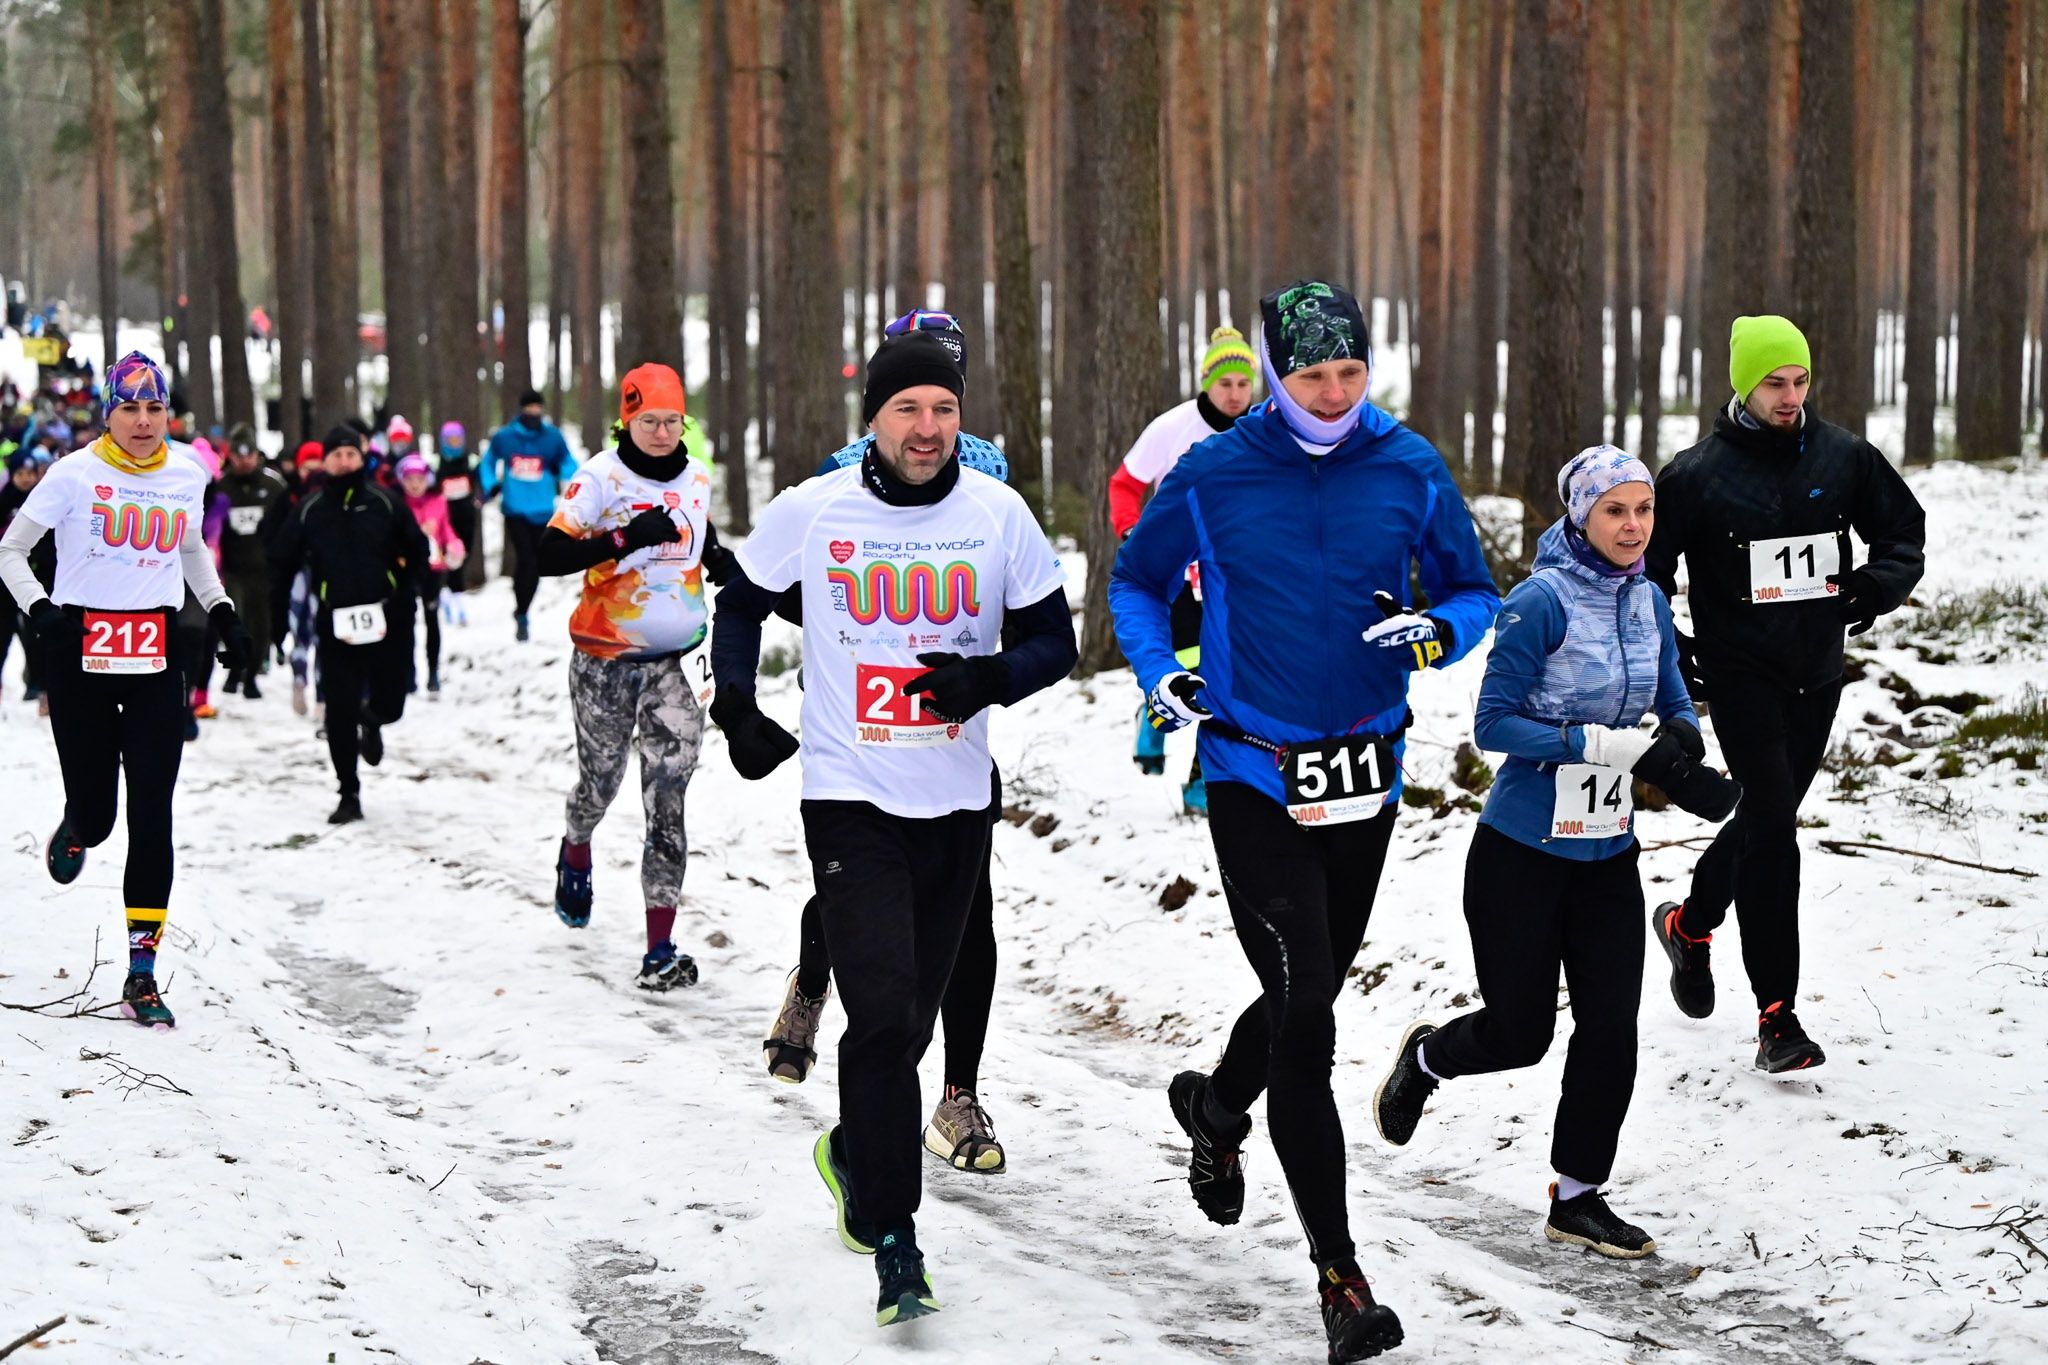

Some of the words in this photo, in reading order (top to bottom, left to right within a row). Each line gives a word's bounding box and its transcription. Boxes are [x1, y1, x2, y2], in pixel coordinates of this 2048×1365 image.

[862, 551, 916, 560] Rozgarty
[863, 540, 902, 552] Biegi
[905, 541, 932, 551] Dla
[935, 538, 985, 551] WOŚP
[1775, 544, 1815, 579] 11
[89, 620, 158, 654] 212
[349, 611, 373, 630] 19
[865, 676, 921, 721] 21
[1297, 743, 1381, 799] 511
[1581, 774, 1622, 813] 14
